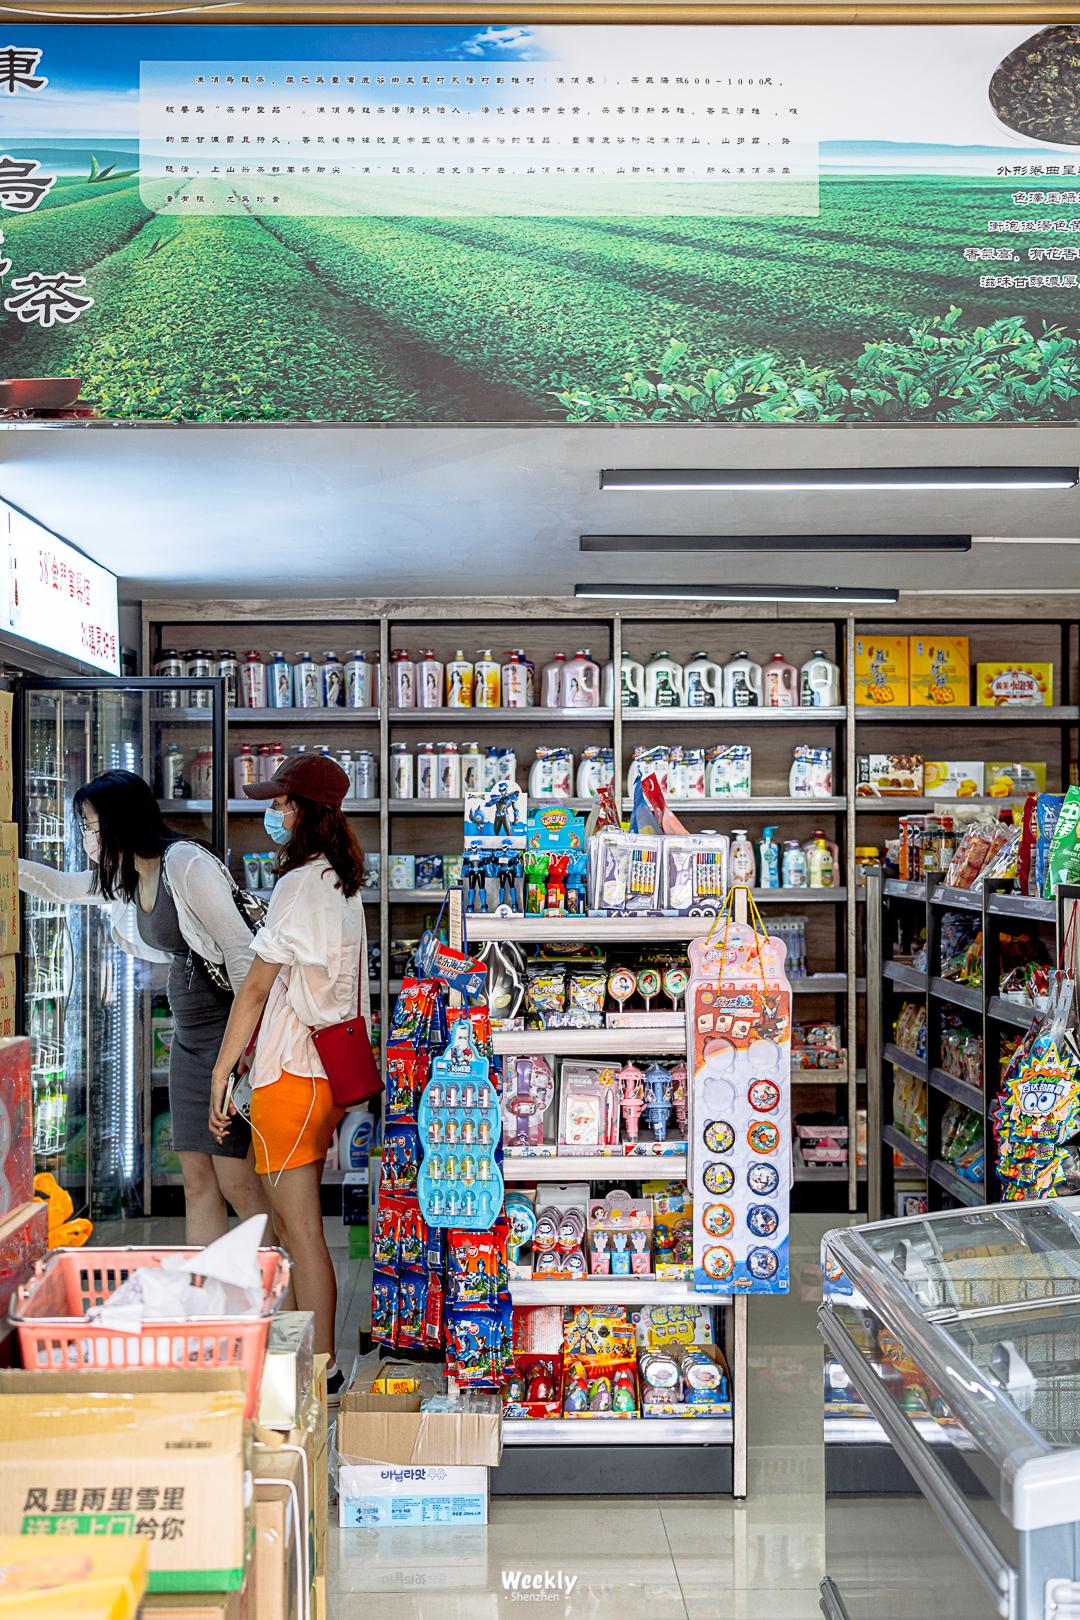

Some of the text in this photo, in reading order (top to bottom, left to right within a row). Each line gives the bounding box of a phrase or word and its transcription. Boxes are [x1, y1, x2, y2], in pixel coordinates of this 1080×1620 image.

[997, 164, 1080, 177] 外形卷曲呈
[23, 1486, 186, 1513] 风里雨里雪里
